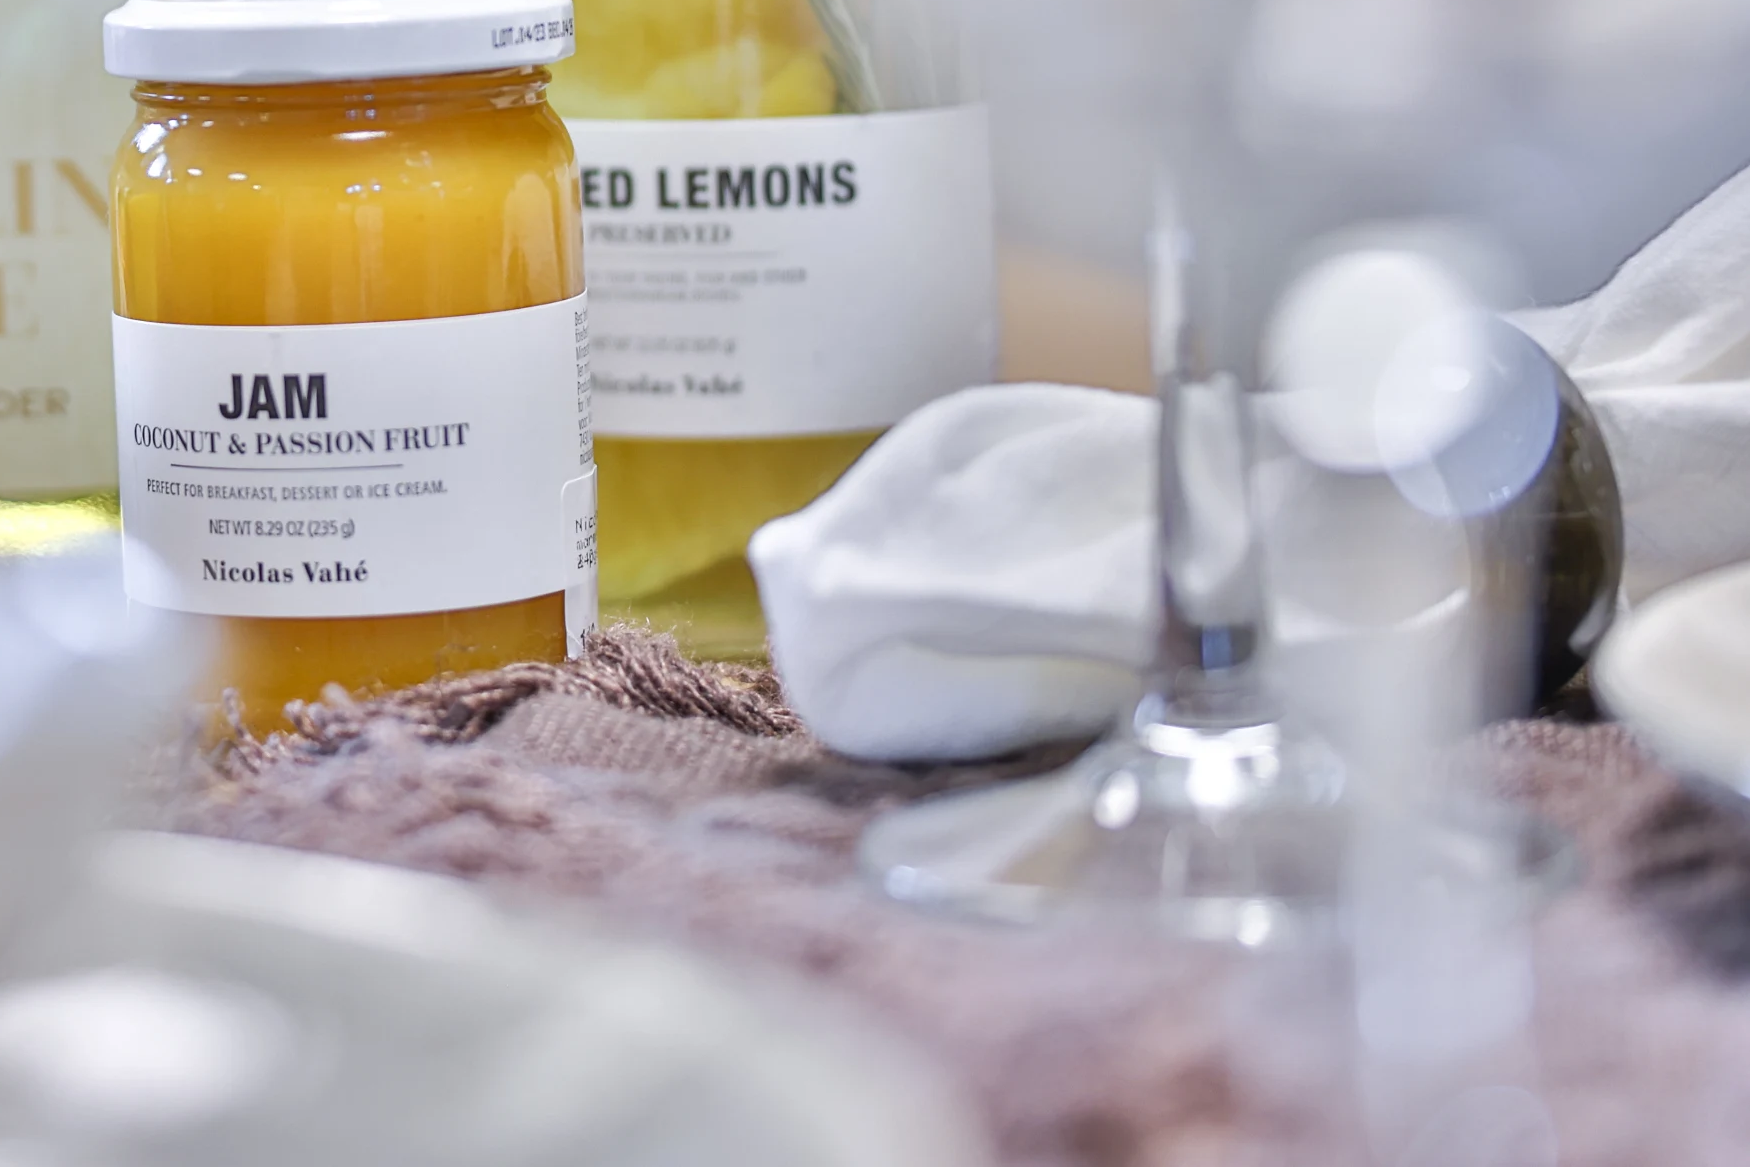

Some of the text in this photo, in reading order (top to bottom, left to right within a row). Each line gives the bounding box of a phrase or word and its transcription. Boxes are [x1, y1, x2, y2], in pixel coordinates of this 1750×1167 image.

[657, 160, 858, 210] LEMONS
[218, 373, 328, 420] JAM
[134, 422, 471, 456] COCONUT & PASSION FRUIT
[147, 478, 448, 502] PERFECT FOR BREAKFAST, DESSERT OR ICE CREAM.
[209, 518, 355, 539] NET WT 8.29 OZ (235 g)
[202, 558, 369, 583] Nicolas Vahé
